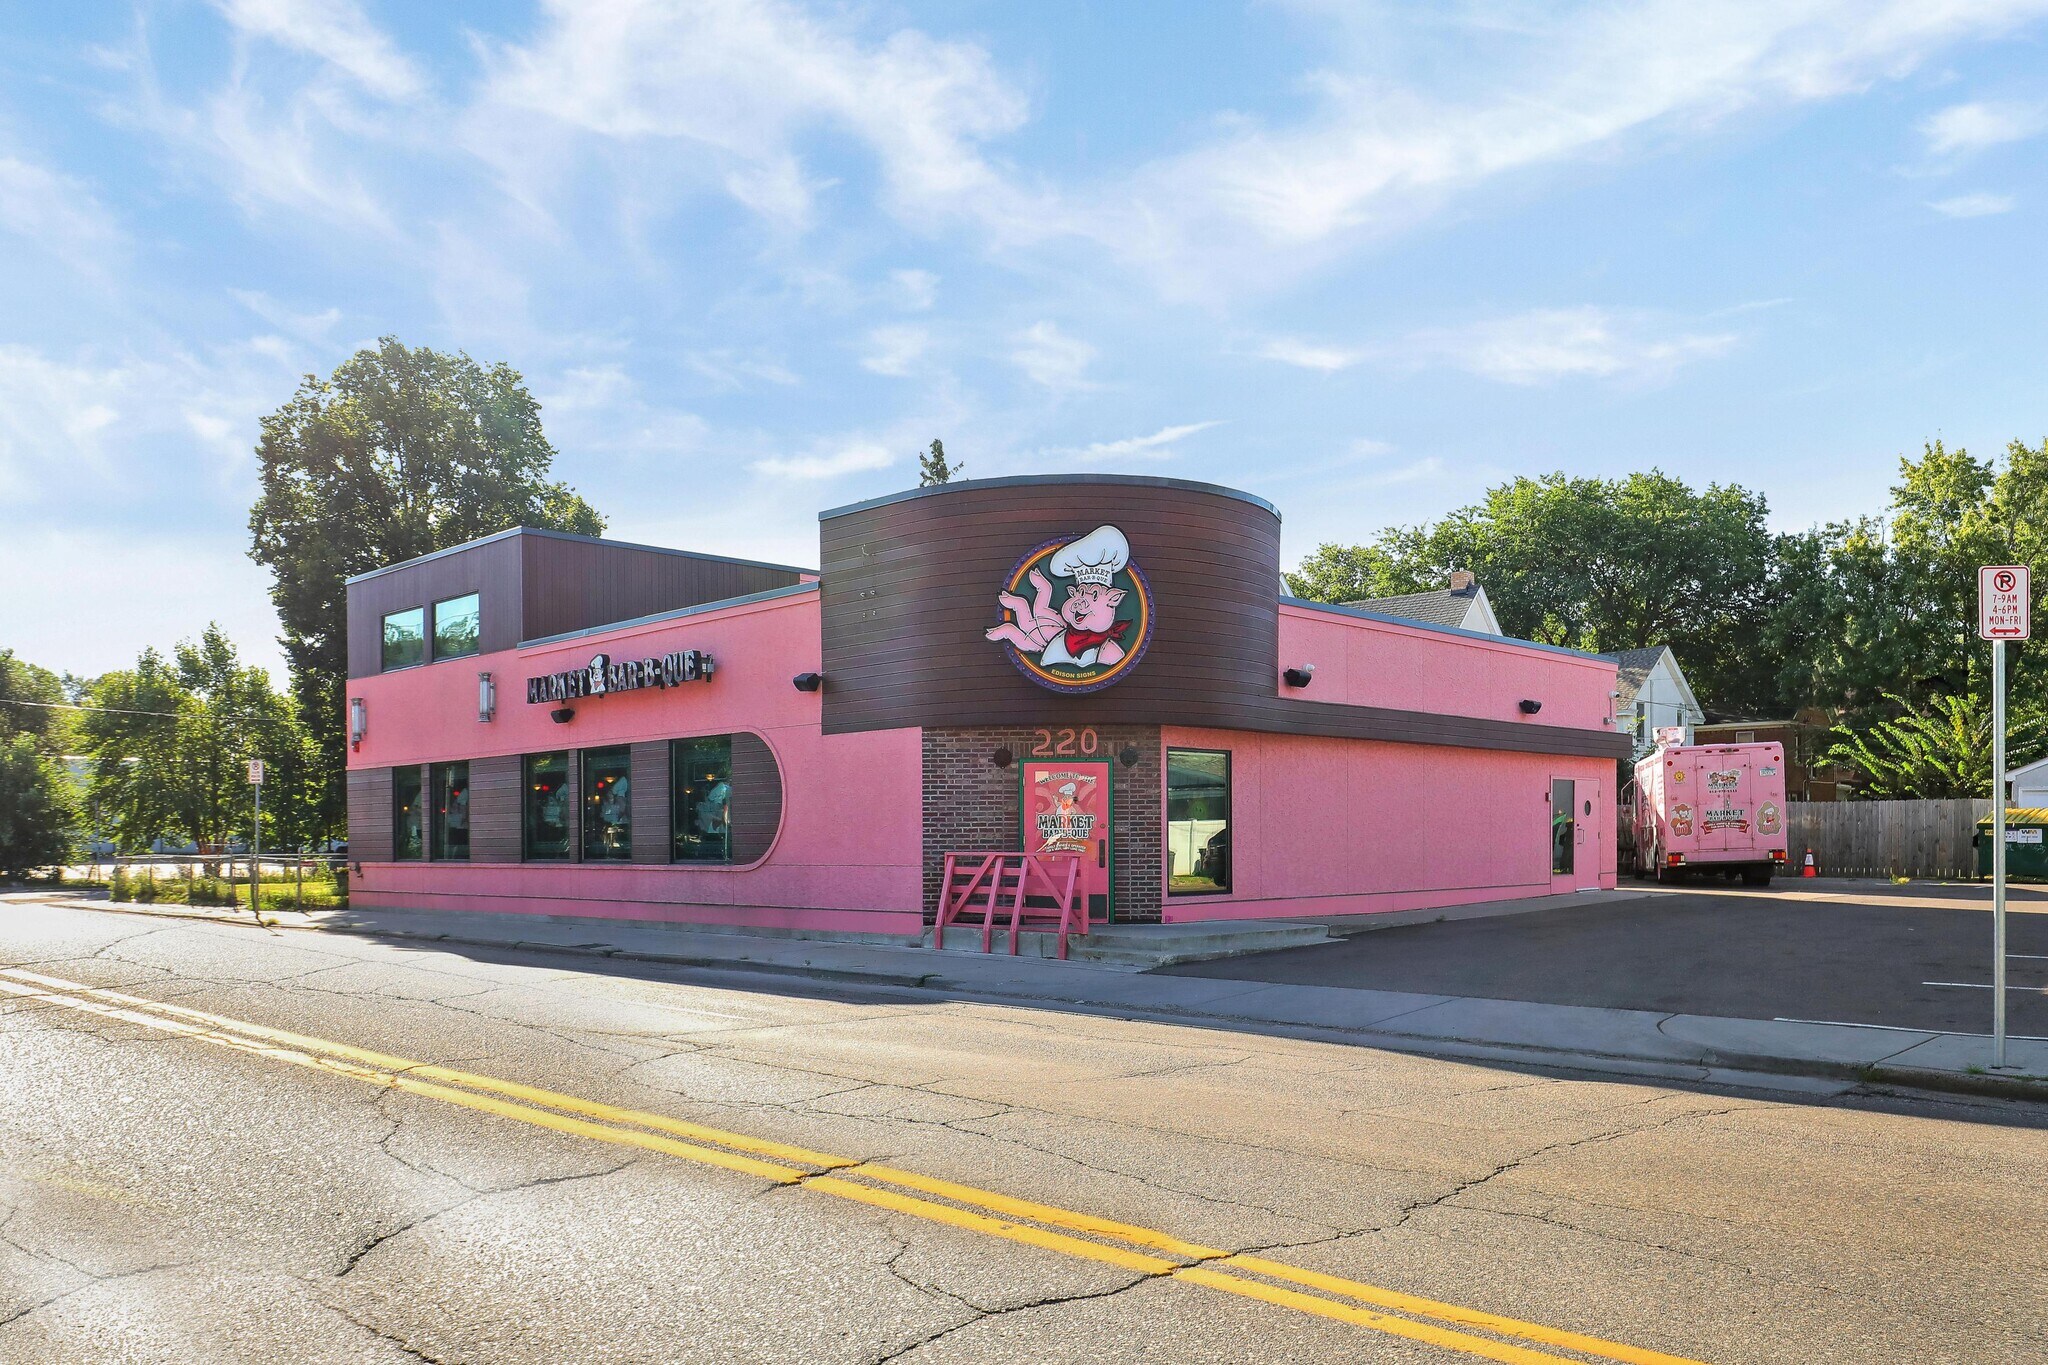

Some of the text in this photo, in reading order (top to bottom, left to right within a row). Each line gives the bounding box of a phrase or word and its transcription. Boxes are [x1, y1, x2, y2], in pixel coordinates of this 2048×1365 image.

[1077, 568, 1110, 577] MARKET
[1989, 616, 2022, 624] MON-FRI
[527, 650, 697, 704] MARKET BAR-B-QUE
[1051, 669, 1096, 679] EDISON SIGNS
[1032, 728, 1098, 756] 220
[1038, 815, 1094, 829] MARKET
